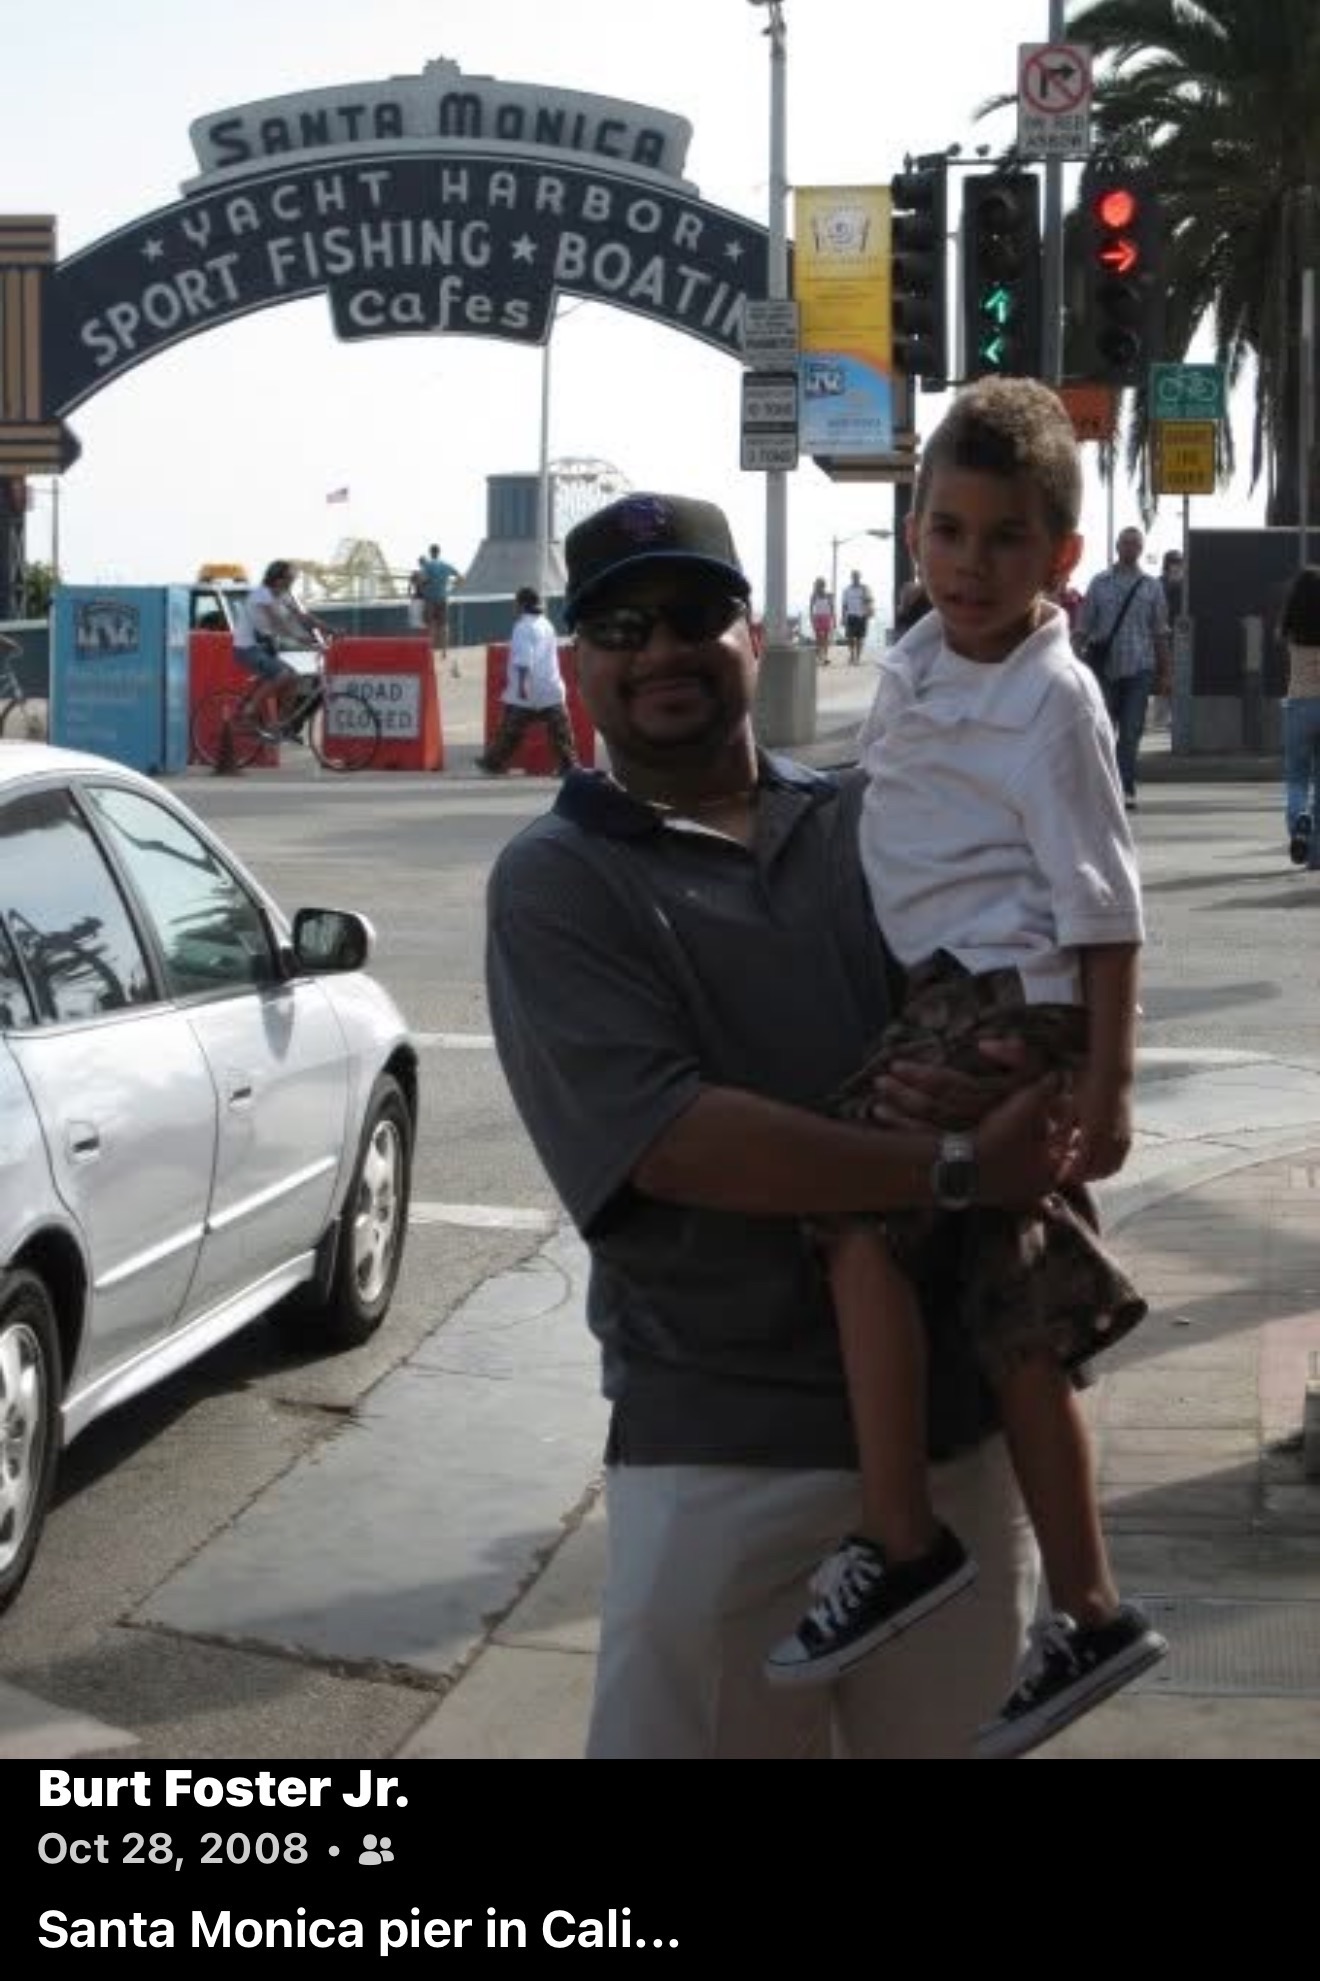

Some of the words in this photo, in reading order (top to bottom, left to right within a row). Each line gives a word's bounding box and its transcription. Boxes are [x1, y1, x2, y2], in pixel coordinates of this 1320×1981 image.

[209, 101, 403, 168] SANTA
[439, 92, 666, 168] MONICA
[182, 170, 393, 246] YACHT
[442, 168, 707, 253] HARBOR
[81, 253, 242, 367] SPORT
[266, 219, 493, 286] FISHING
[553, 234, 746, 352] BOATIN
